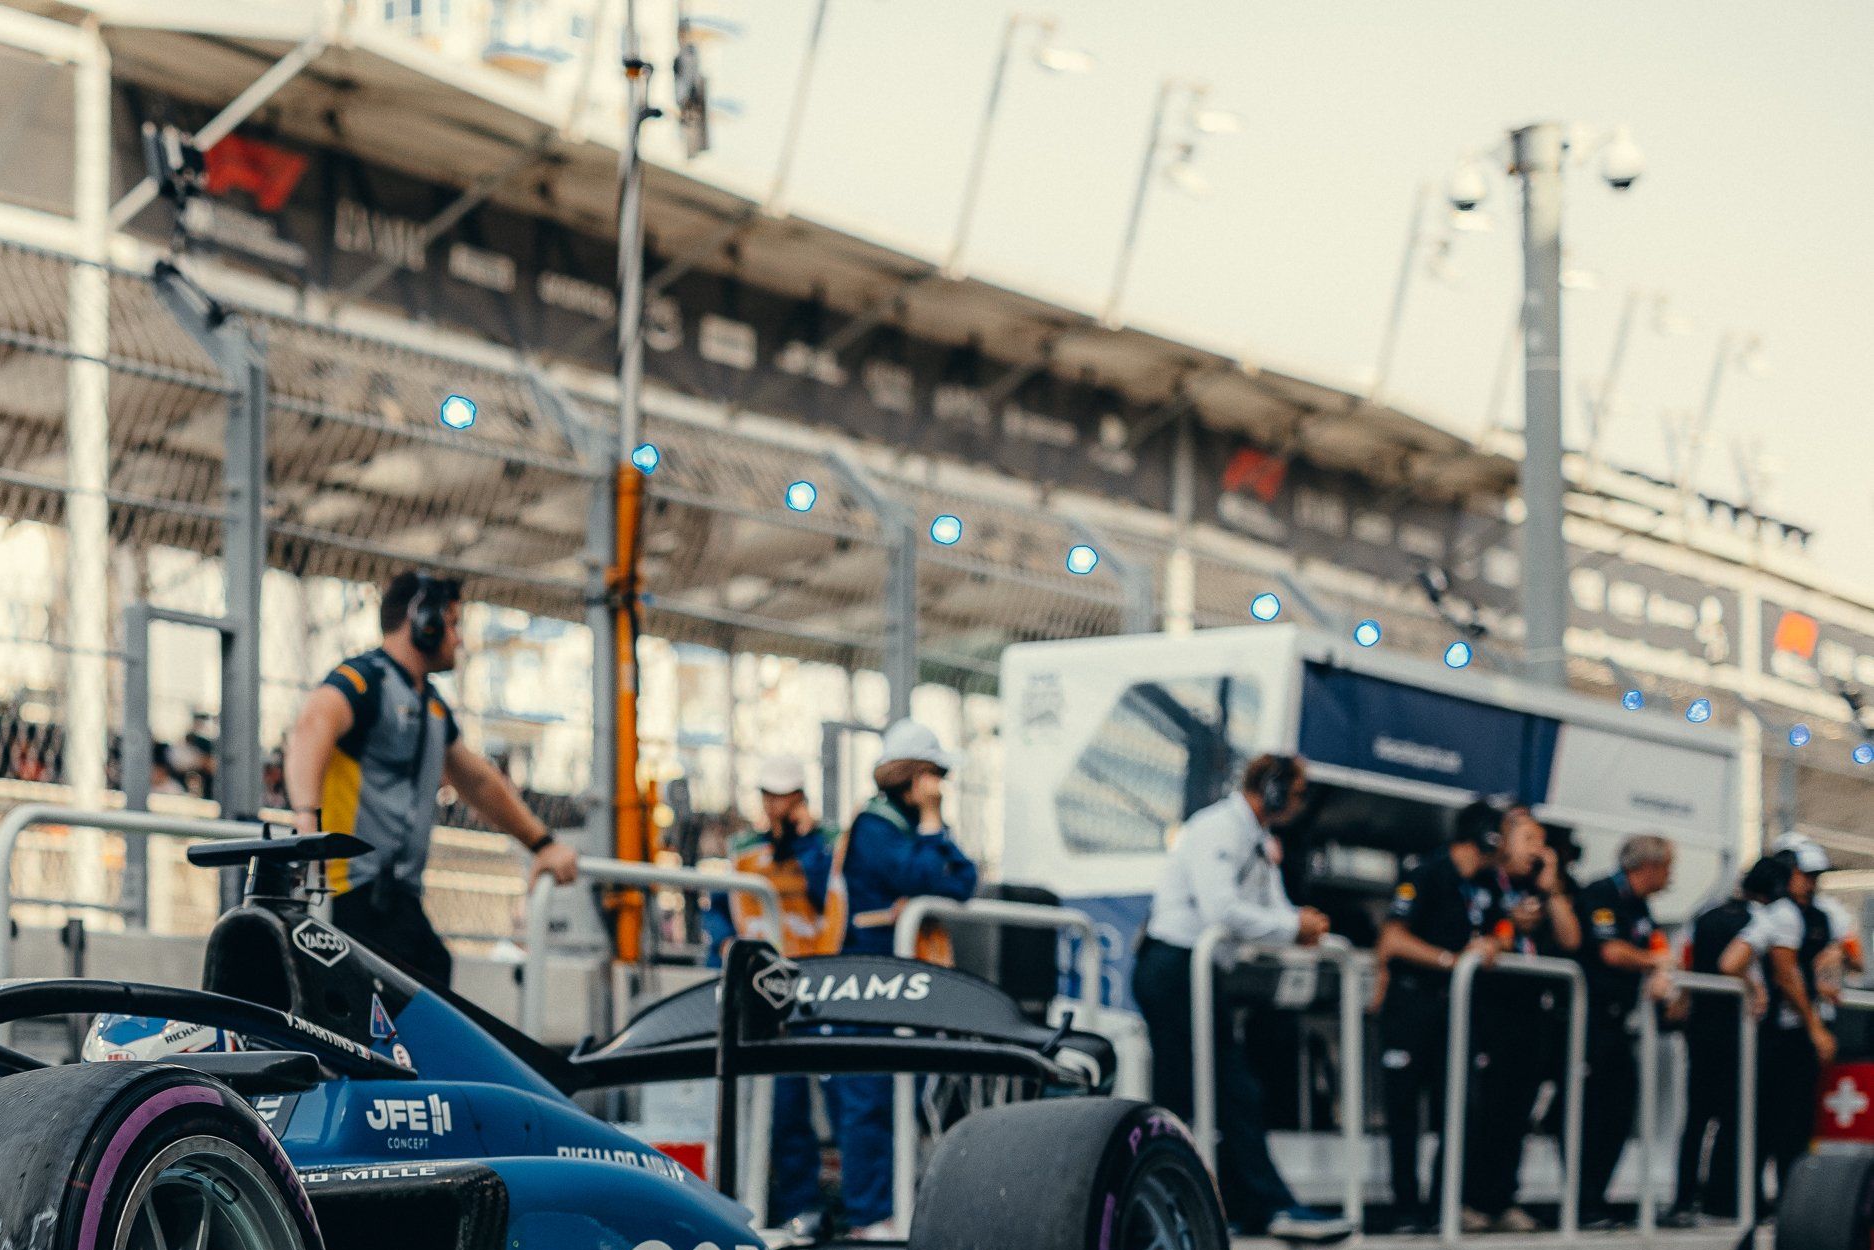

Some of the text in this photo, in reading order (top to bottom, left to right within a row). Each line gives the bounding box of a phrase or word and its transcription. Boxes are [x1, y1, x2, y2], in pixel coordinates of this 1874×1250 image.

[299, 930, 347, 953] YACCO
[795, 972, 933, 1003] LIAMS
[165, 1022, 207, 1045] RICHAR
[387, 1137, 429, 1150] CONCEPT
[342, 1166, 437, 1182] MILLE
